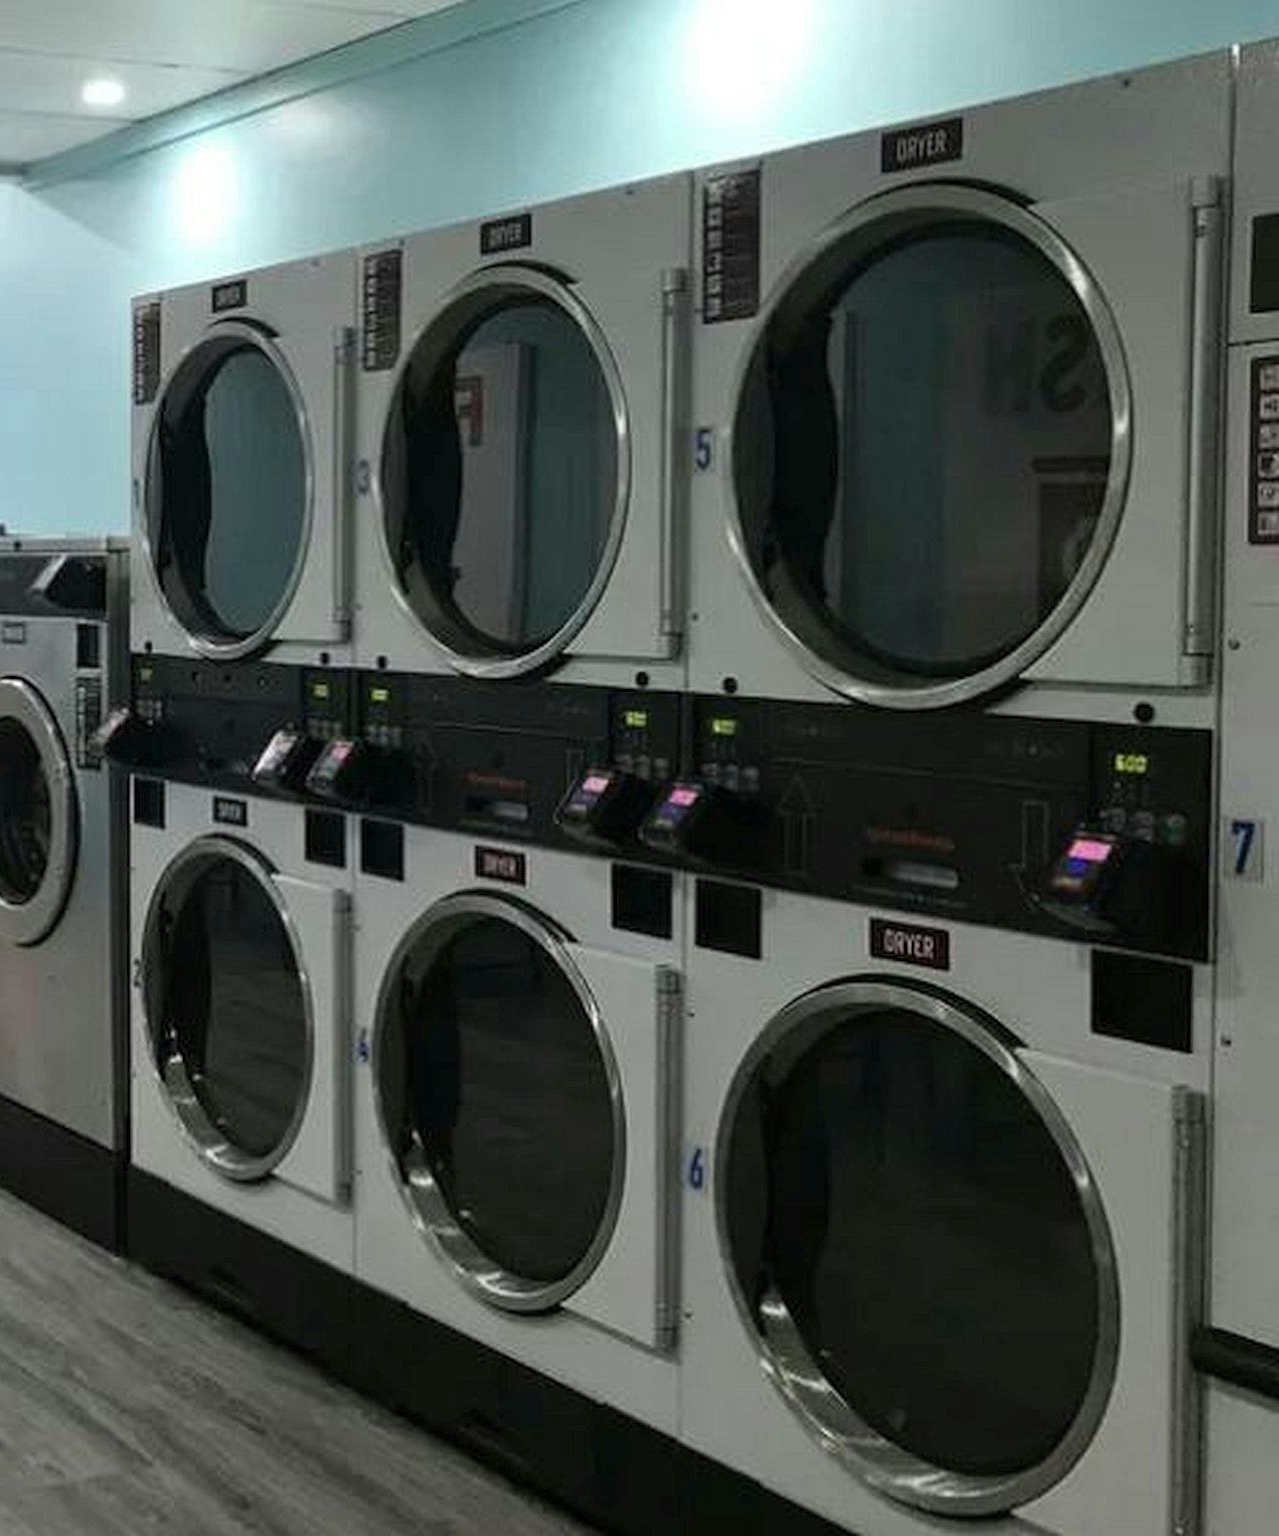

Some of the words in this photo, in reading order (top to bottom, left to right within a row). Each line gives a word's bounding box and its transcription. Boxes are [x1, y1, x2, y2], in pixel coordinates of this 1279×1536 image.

[896, 128, 947, 162] DRYER
[695, 428, 711, 472] 5
[1230, 820, 1256, 875] 7
[883, 927, 935, 960] DRYER
[689, 1146, 704, 1190] 6
